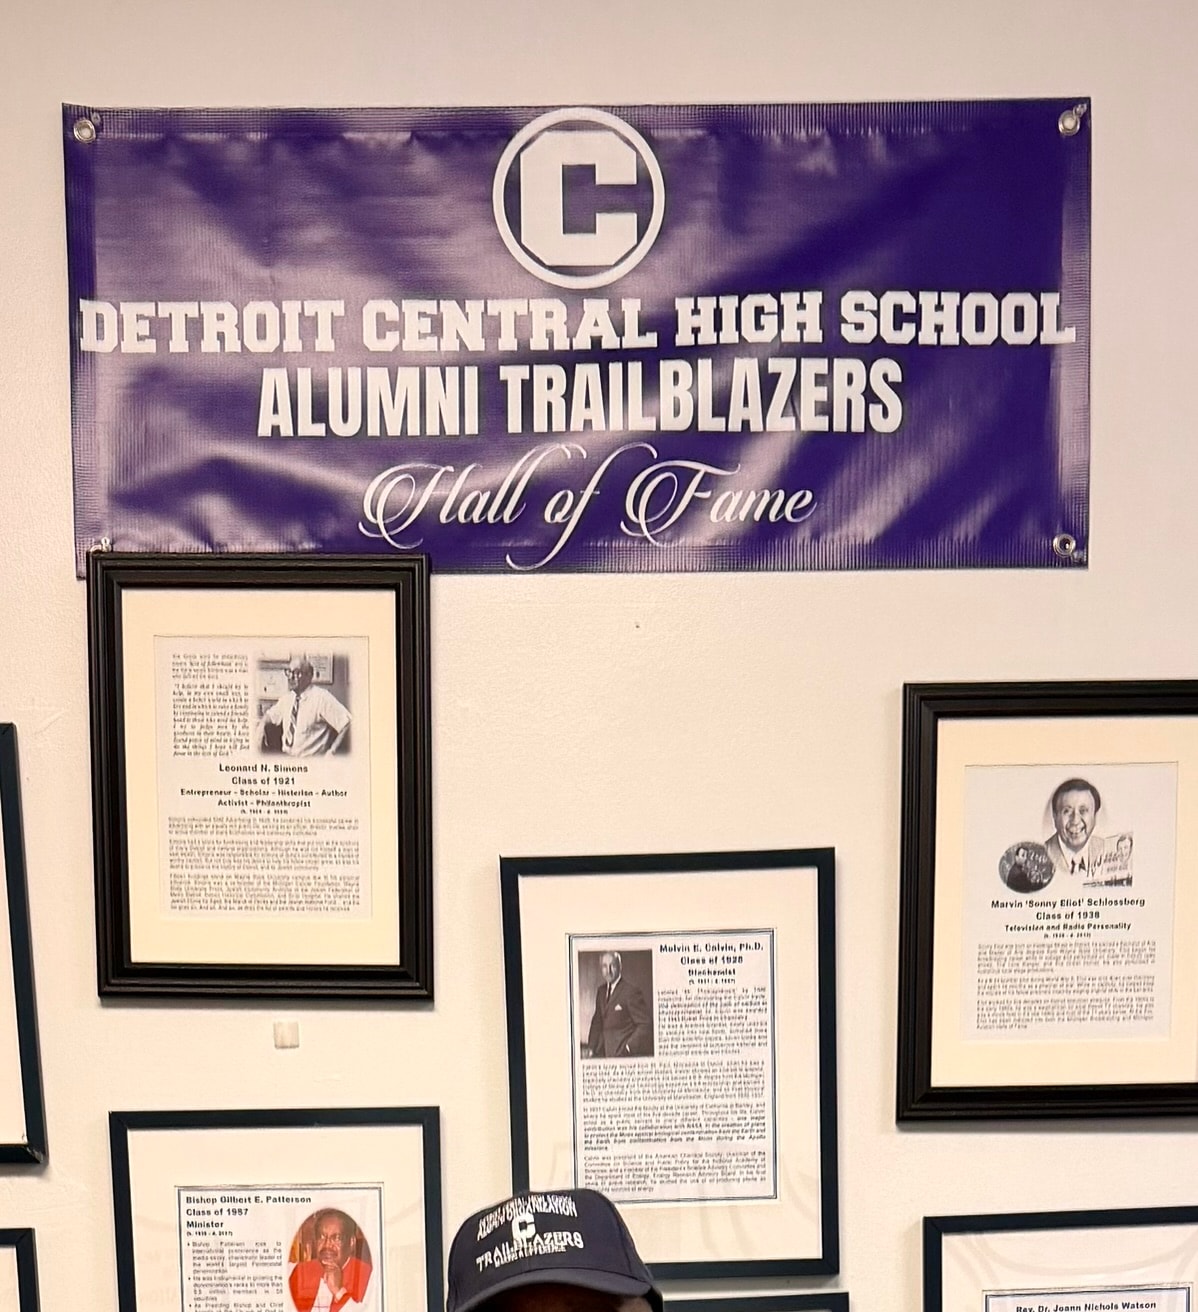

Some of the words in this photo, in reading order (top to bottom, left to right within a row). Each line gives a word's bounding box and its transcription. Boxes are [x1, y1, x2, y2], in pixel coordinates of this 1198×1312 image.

[521, 128, 638, 267] C
[79, 298, 345, 353] DETROIT
[363, 297, 659, 352] CENTRAL
[675, 290, 824, 347] HIGH
[839, 288, 1076, 346] SCHOOL
[256, 363, 479, 439] ALUMNI
[499, 357, 904, 435] TRAILBLAZERS
[358, 443, 587, 549] Hall
[505, 442, 658, 571] of
[619, 459, 819, 548] Fame
[219, 764, 258, 772] Leonard
[261, 764, 270, 772] N.
[274, 765, 308, 773] Simons
[232, 776, 258, 785] Class
[261, 777, 270, 785] of
[274, 777, 295, 785] 1921
[256, 800, 311, 808] Philanthropist
[1036, 912, 1062, 920] Class
[1065, 911, 1074, 920] of
[1006, 924, 1044, 932] Television
[1087, 922, 1131, 931] Personality
[681, 956, 706, 965] Class
[709, 956, 718, 964] of
[186, 1196, 217, 1205] Bishop
[220, 1196, 252, 1204] Gilbert
[186, 1208, 211, 1216] Class
[214, 1208, 223, 1216] of
[1038, 1305, 1050, 1312] Dr.
[1053, 1304, 1081, 1312] Joann
[1084, 1302, 1118, 1311] Nichols
[1122, 1301, 1156, 1310] Watson
